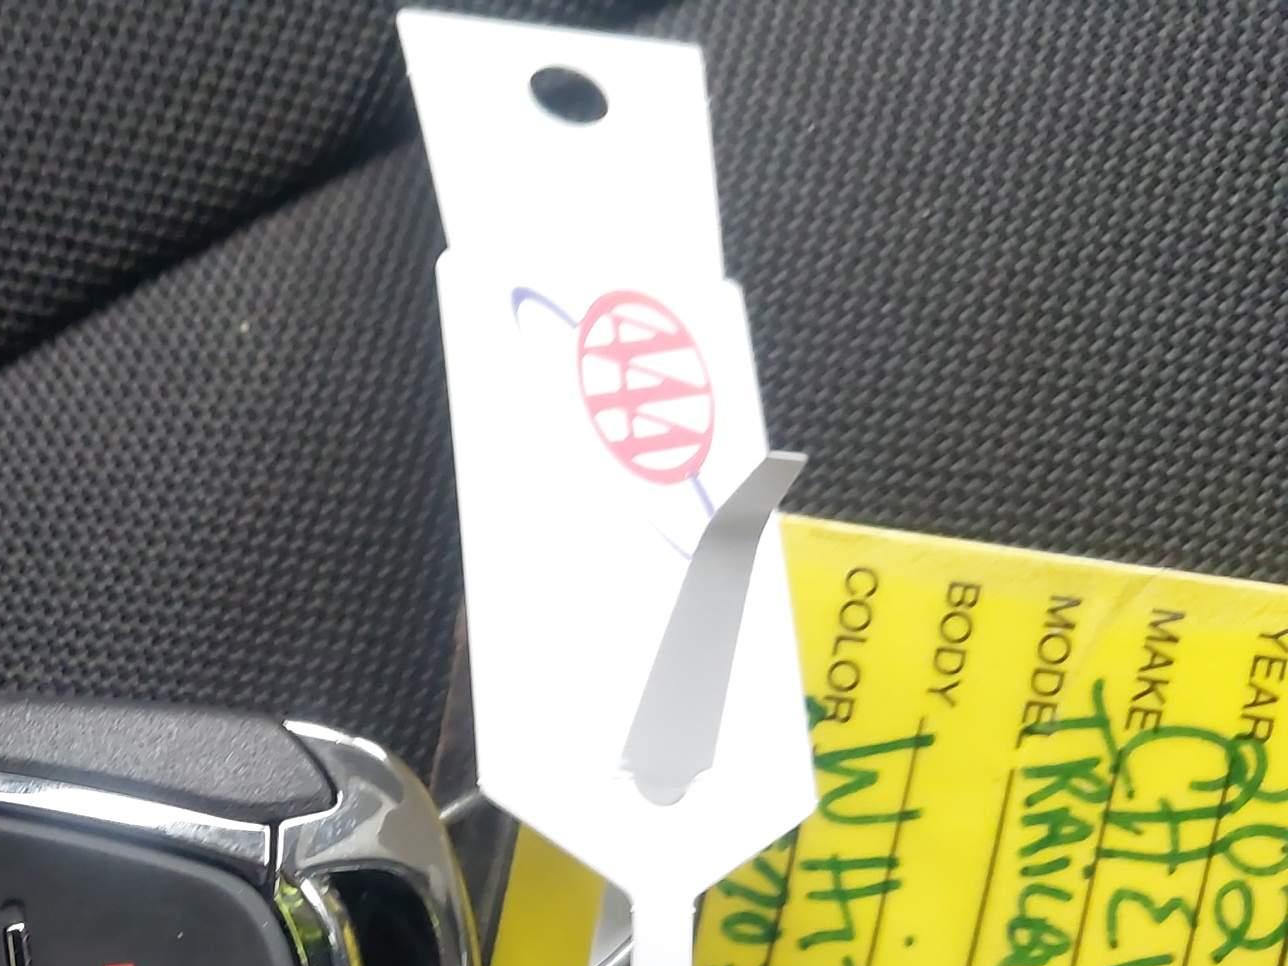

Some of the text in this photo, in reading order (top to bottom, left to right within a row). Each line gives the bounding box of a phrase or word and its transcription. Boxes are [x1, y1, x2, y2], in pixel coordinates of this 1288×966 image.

[580, 310, 712, 462] AAA
[823, 567, 879, 724] COLOR
[926, 581, 982, 708] BODY
[1015, 595, 1083, 749] MODEL
[1125, 607, 1186, 733] MAKE
[1239, 628, 1288, 744] YEAR
